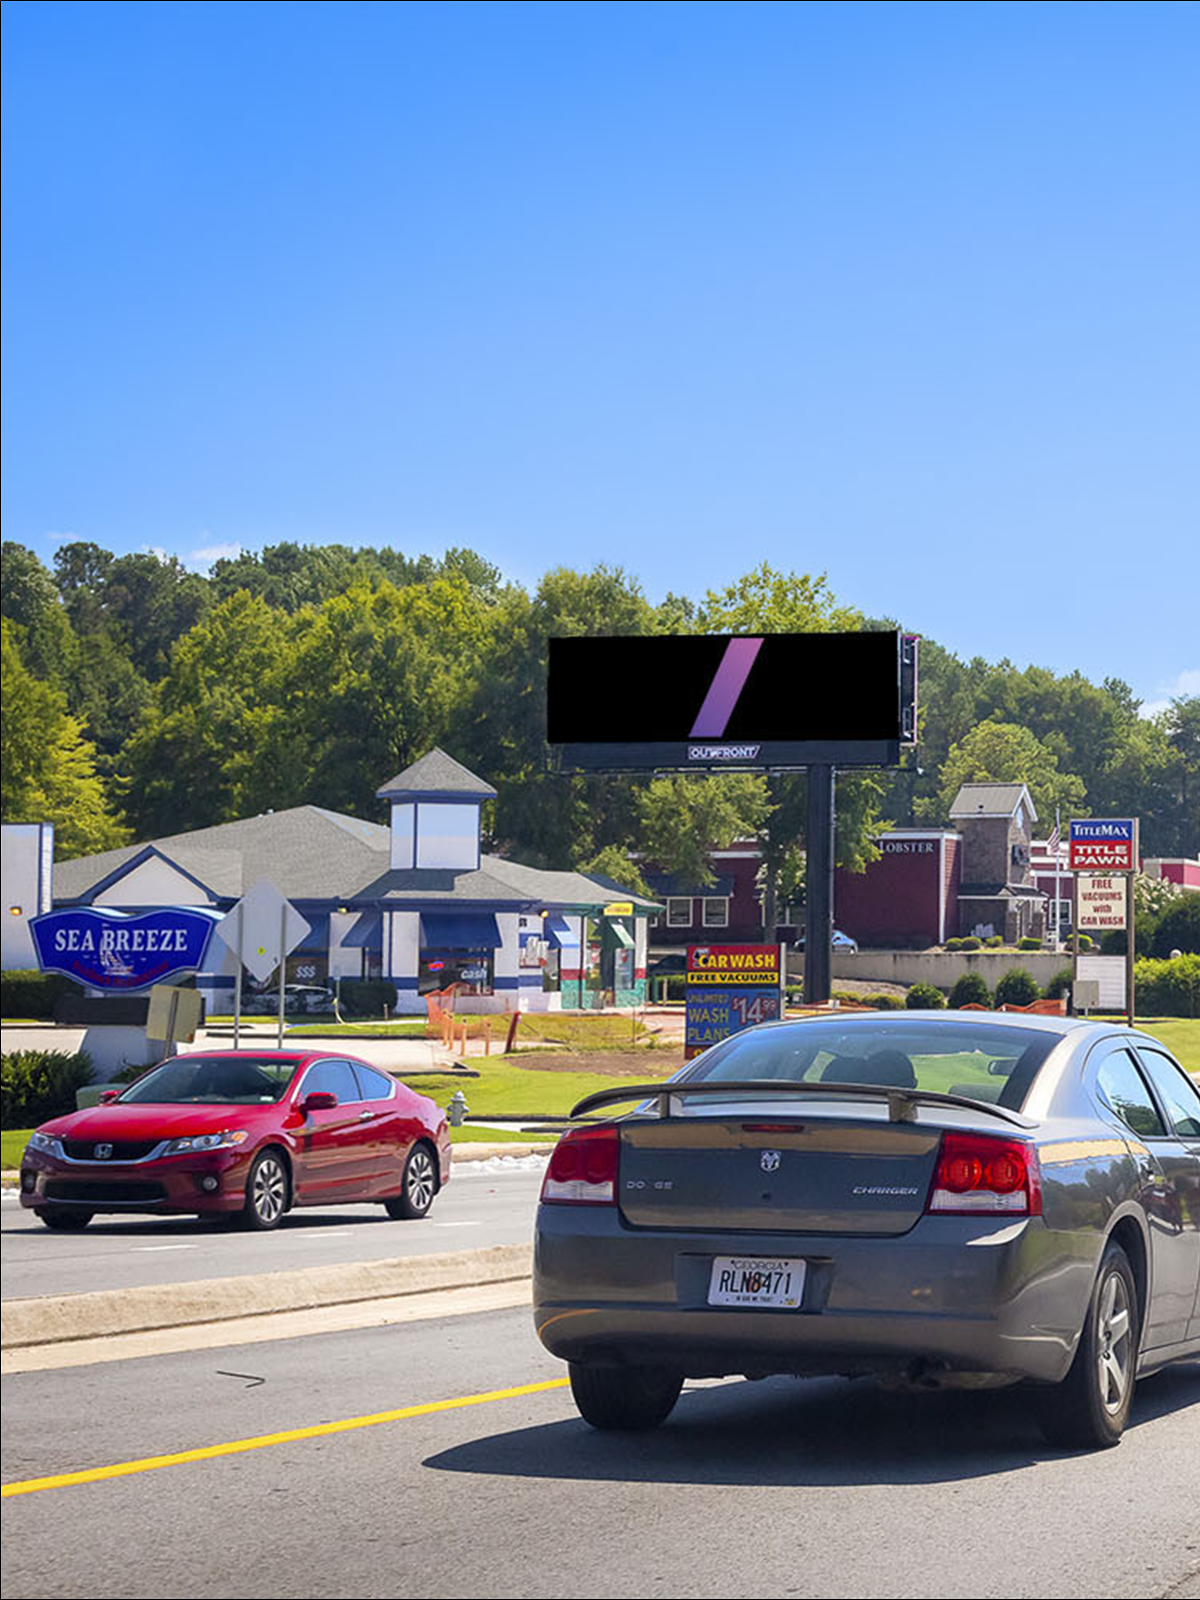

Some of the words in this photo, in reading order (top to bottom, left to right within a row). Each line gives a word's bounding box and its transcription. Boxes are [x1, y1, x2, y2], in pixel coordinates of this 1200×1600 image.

[880, 841, 934, 853] LOBSTER
[1074, 845, 1127, 855] TITLE
[1074, 855, 1128, 865] PAWN
[1092, 879, 1113, 889] FREE
[1082, 891, 1123, 901] VACUUMS
[1093, 904, 1112, 913] with
[1081, 916, 1098, 926] CAR
[1099, 916, 1124, 926] WASH
[54, 929, 95, 951] SEA
[100, 928, 188, 951] BREEZE
[719, 973, 776, 981] VACUUMS
[688, 1008, 729, 1023] WASH
[853, 1187, 918, 1195] CHARGER
[719, 1270, 791, 1294] RLN8471
